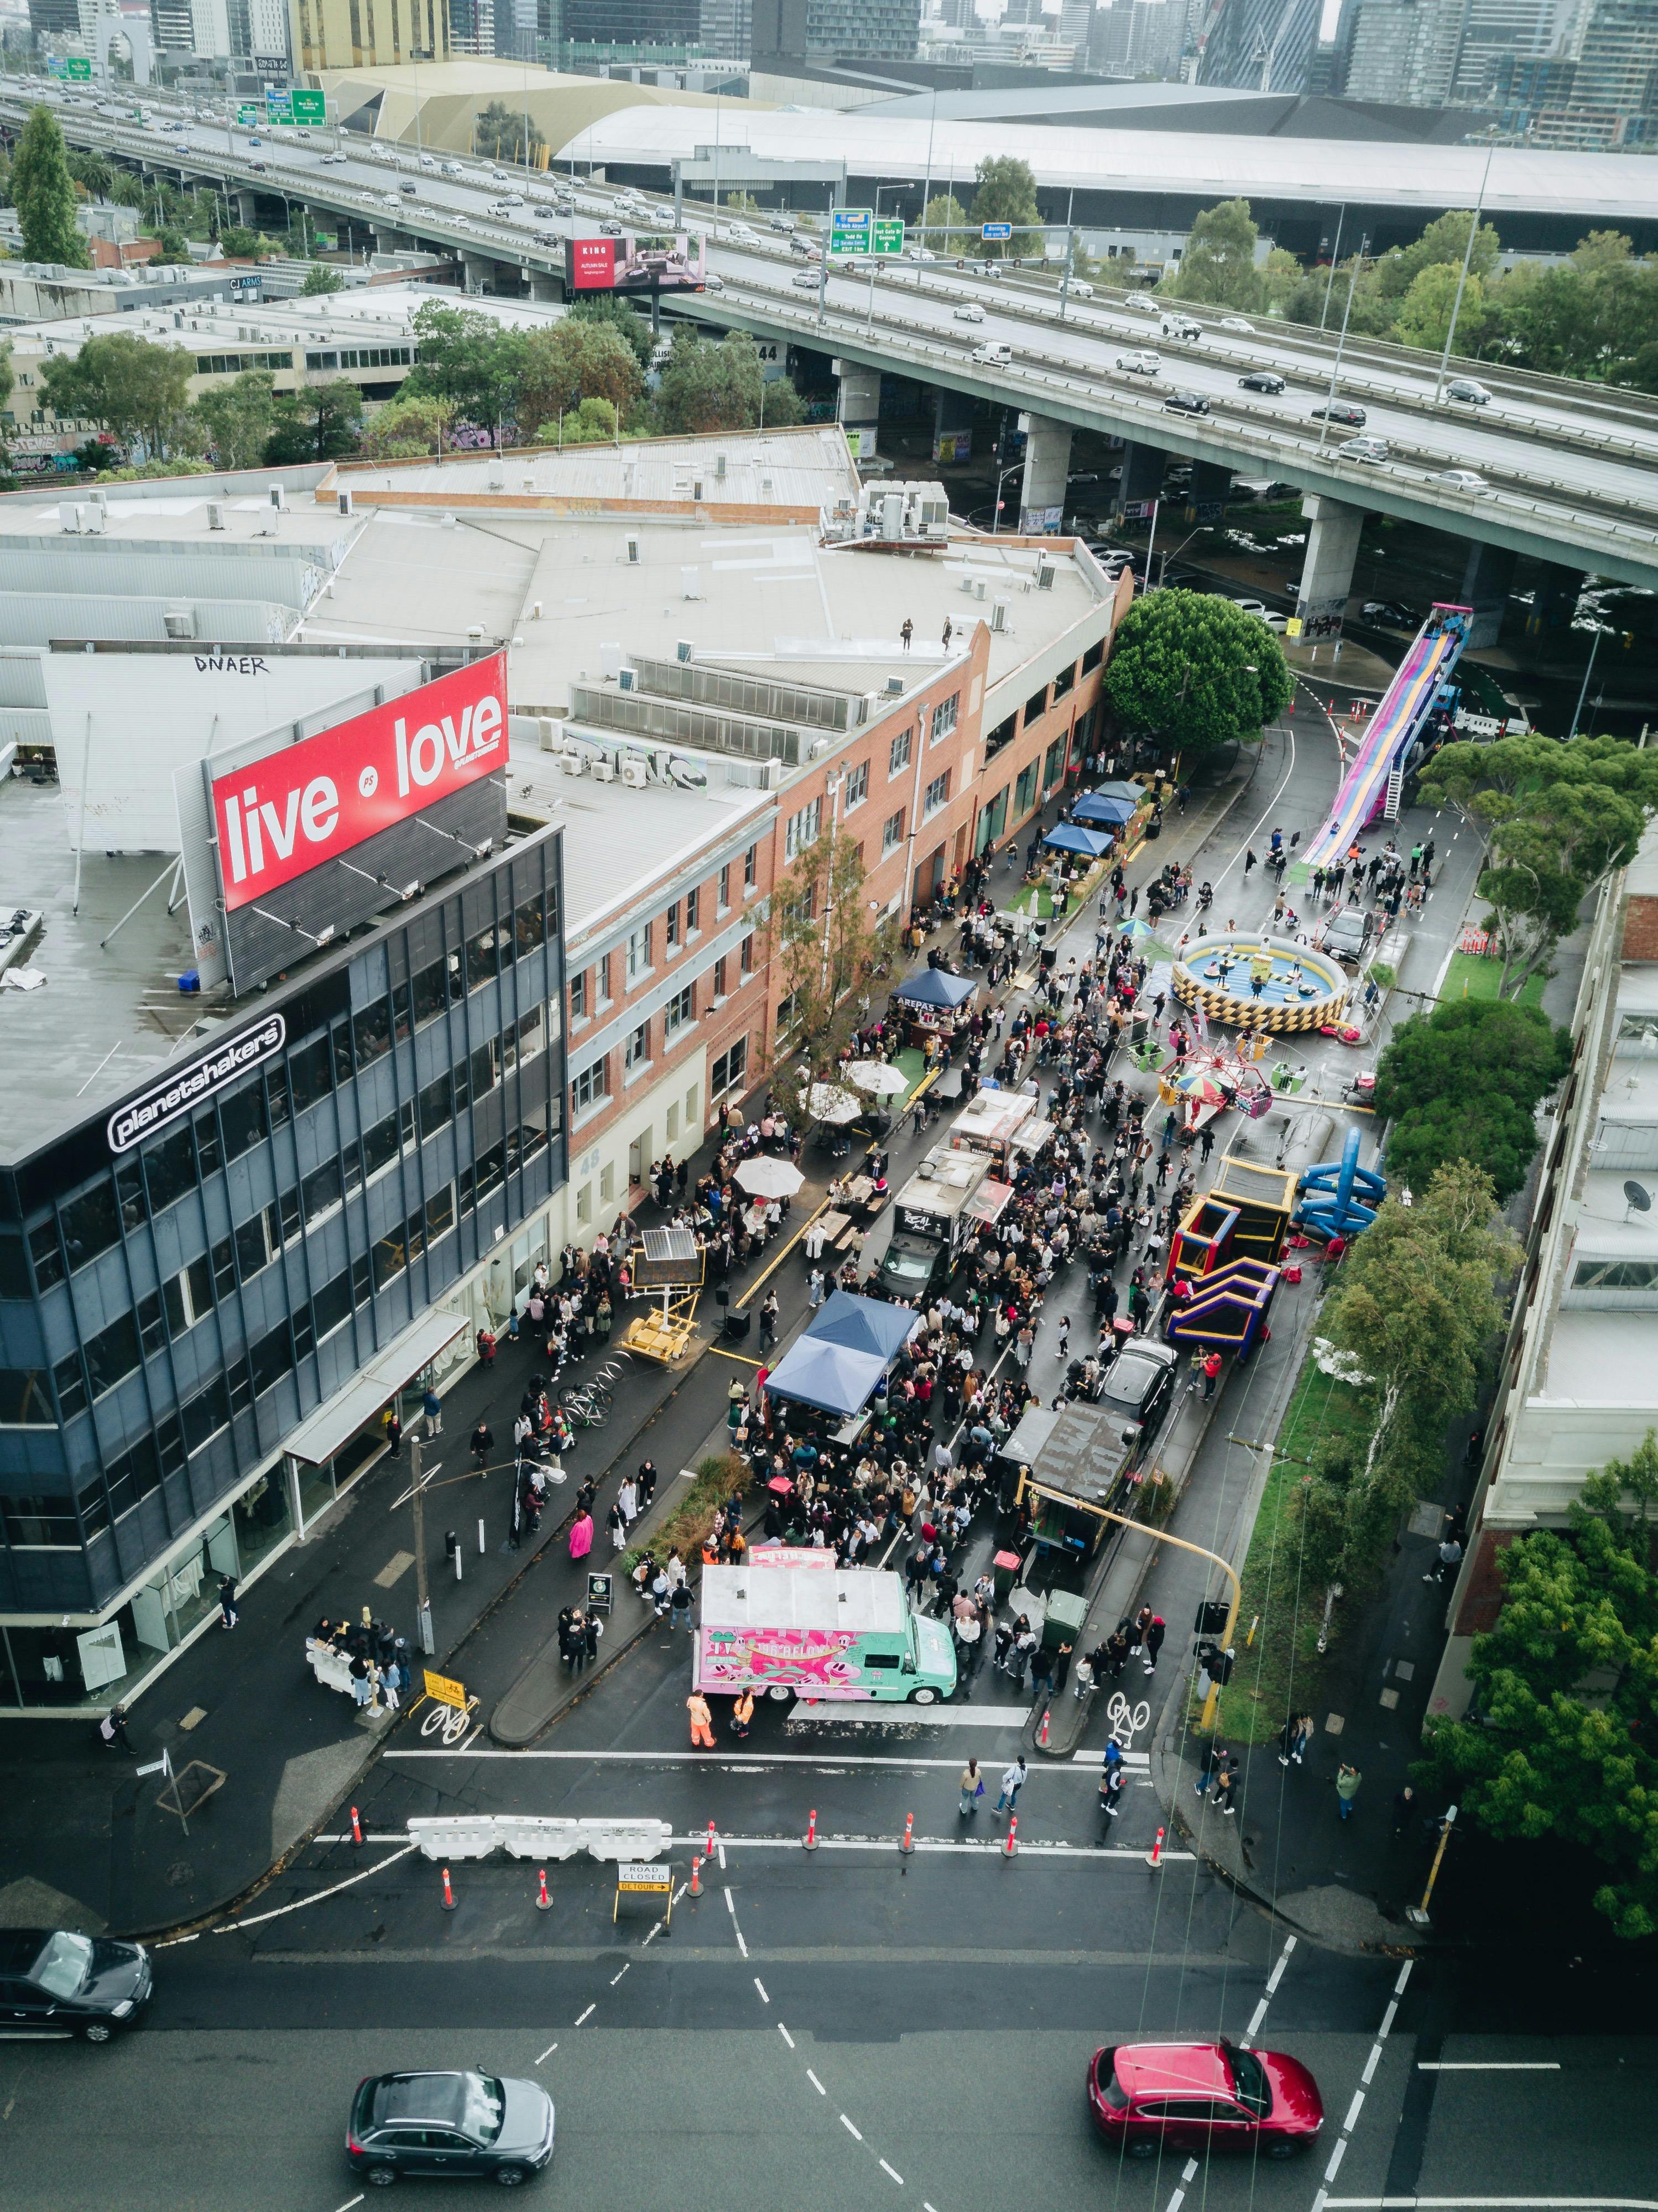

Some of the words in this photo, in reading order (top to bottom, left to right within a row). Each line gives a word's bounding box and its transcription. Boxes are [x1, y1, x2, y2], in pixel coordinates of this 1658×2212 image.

[230, 279, 240, 289] CJ
[242, 276, 261, 288] ARMS
[195, 656, 270, 675] DNAER
[225, 776, 339, 884] live
[363, 775, 374, 789] PS
[395, 696, 502, 798] love
[897, 997, 934, 1012] AREPAS
[117, 1026, 278, 1145] planetshakers
[972, 1148, 994, 1158] FAMOUS
[580, 1148, 599, 1176] 48
[904, 1216, 932, 1227] REAL
